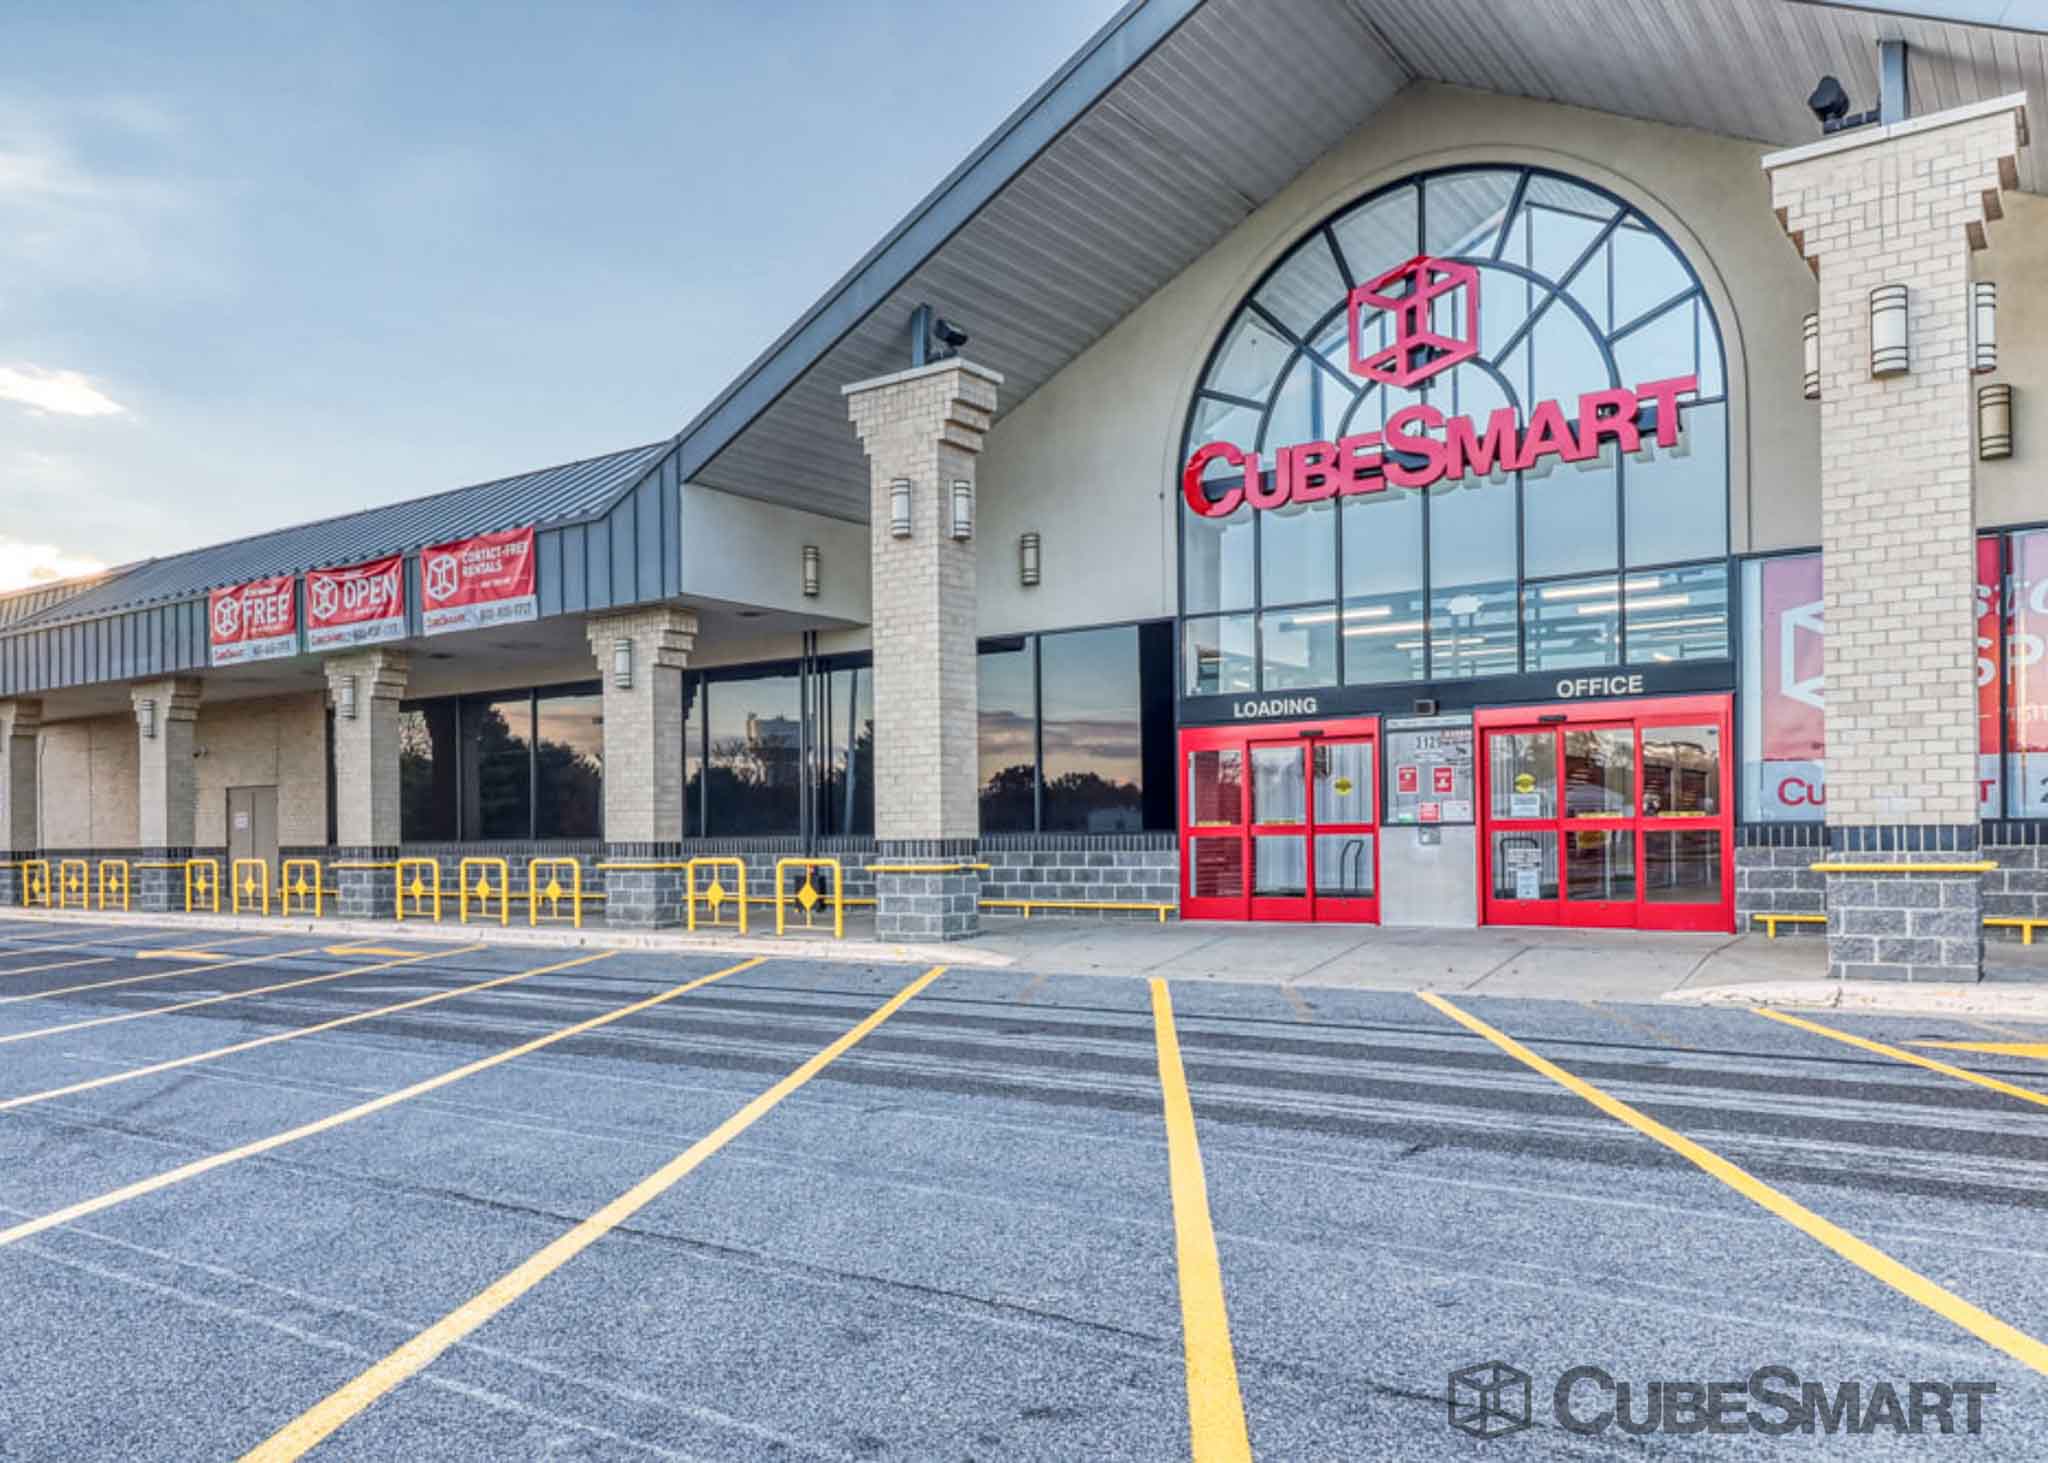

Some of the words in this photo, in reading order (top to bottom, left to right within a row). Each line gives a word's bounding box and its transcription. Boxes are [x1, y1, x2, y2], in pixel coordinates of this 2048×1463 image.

[1183, 374, 1698, 518] CUBESMART
[344, 572, 397, 609] OPEN
[243, 592, 290, 626] FREE
[1556, 674, 1643, 698] OFFICE
[1233, 697, 1317, 719] LOADING
